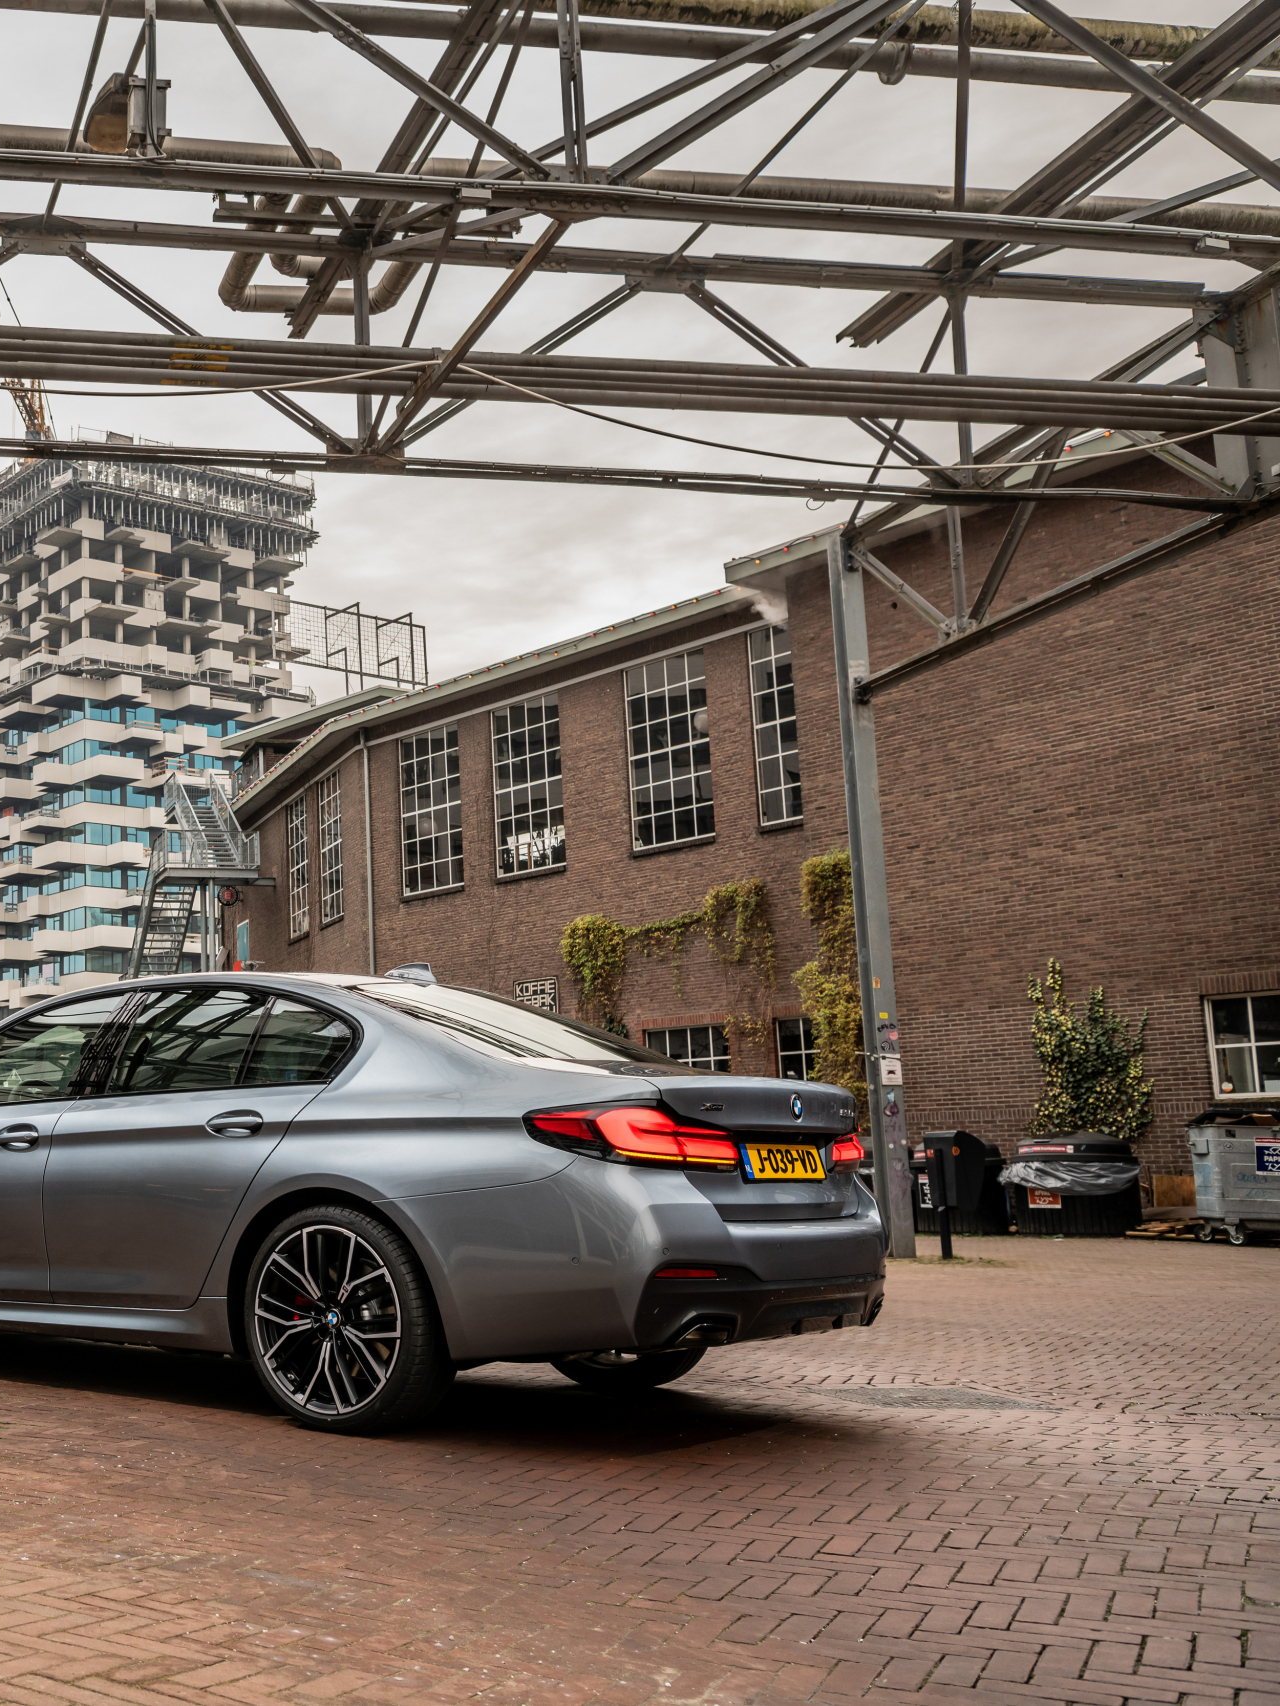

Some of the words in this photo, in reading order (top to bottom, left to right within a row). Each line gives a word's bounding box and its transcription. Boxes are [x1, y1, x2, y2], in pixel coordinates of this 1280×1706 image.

[515, 980, 555, 997] KOFFIE
[516, 993, 555, 1007] EBAK
[756, 1148, 818, 1174] J-039-VD
[1264, 1155, 1280, 1163] PAP
[745, 1164, 753, 1173] NL
